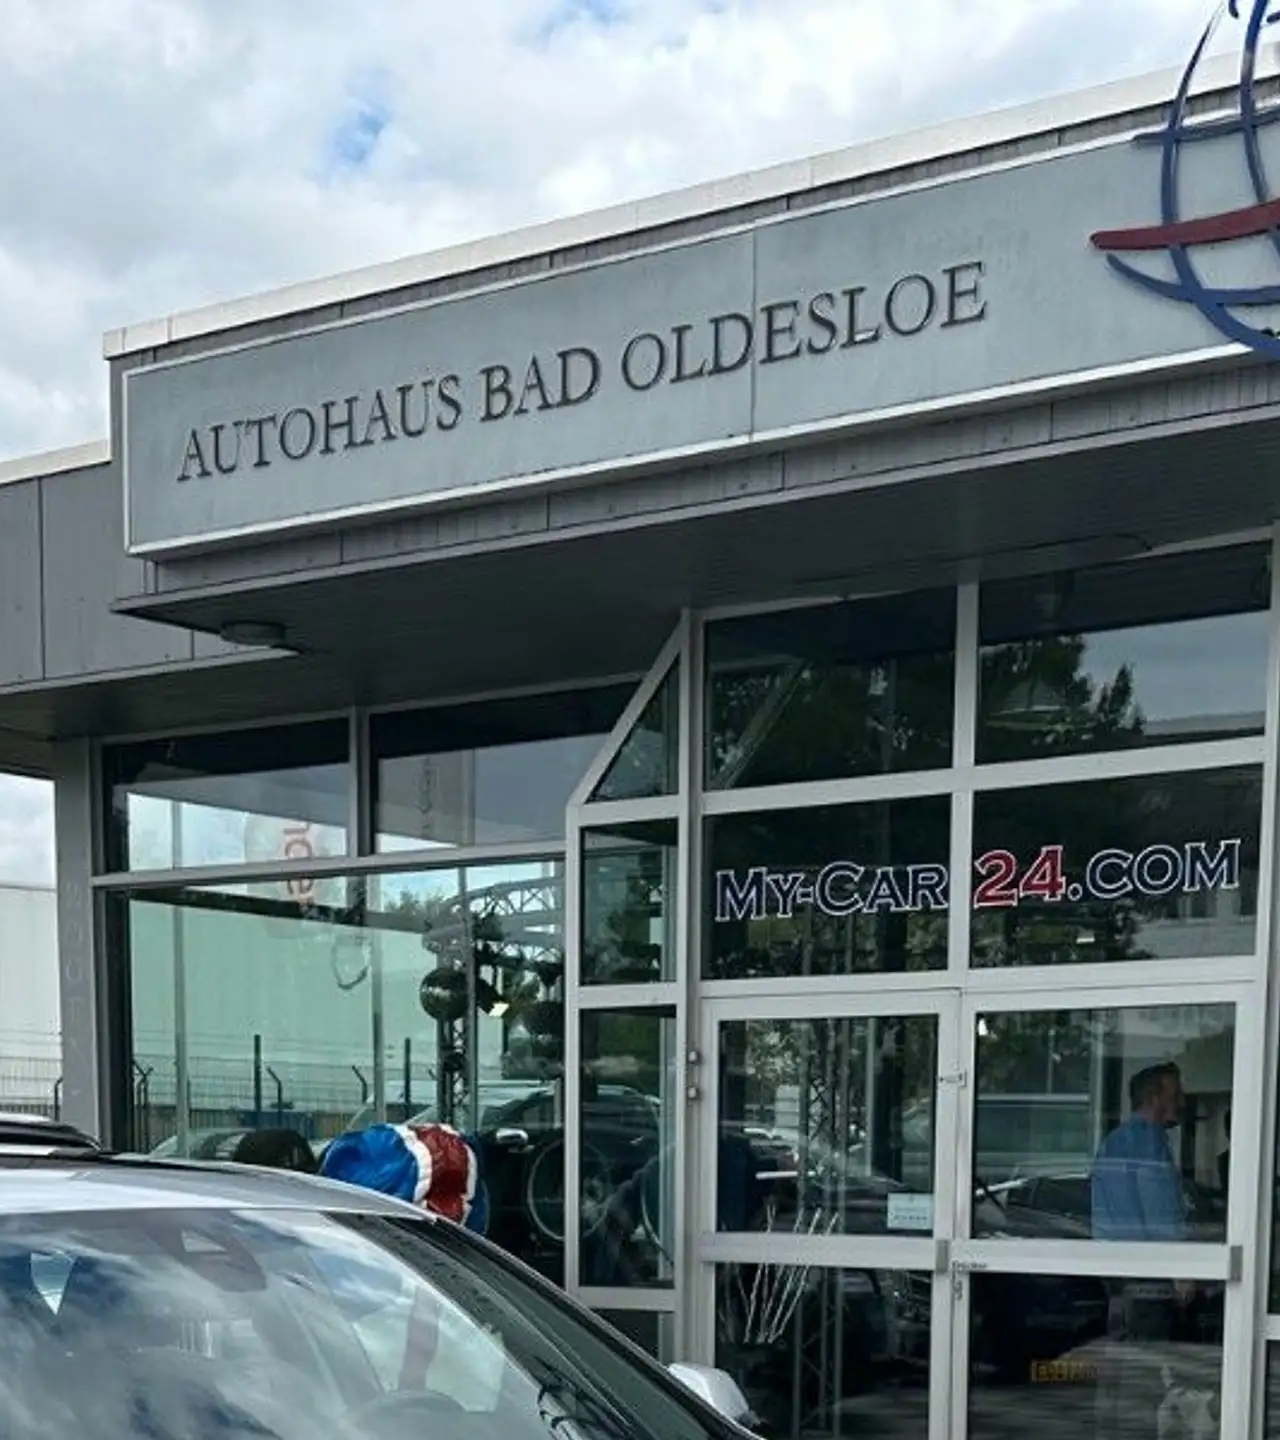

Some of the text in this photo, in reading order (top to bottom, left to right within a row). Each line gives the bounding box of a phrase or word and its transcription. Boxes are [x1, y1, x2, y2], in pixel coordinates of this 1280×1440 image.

[177, 261, 988, 484] AUTOHAUS BAD OLDESLOE
